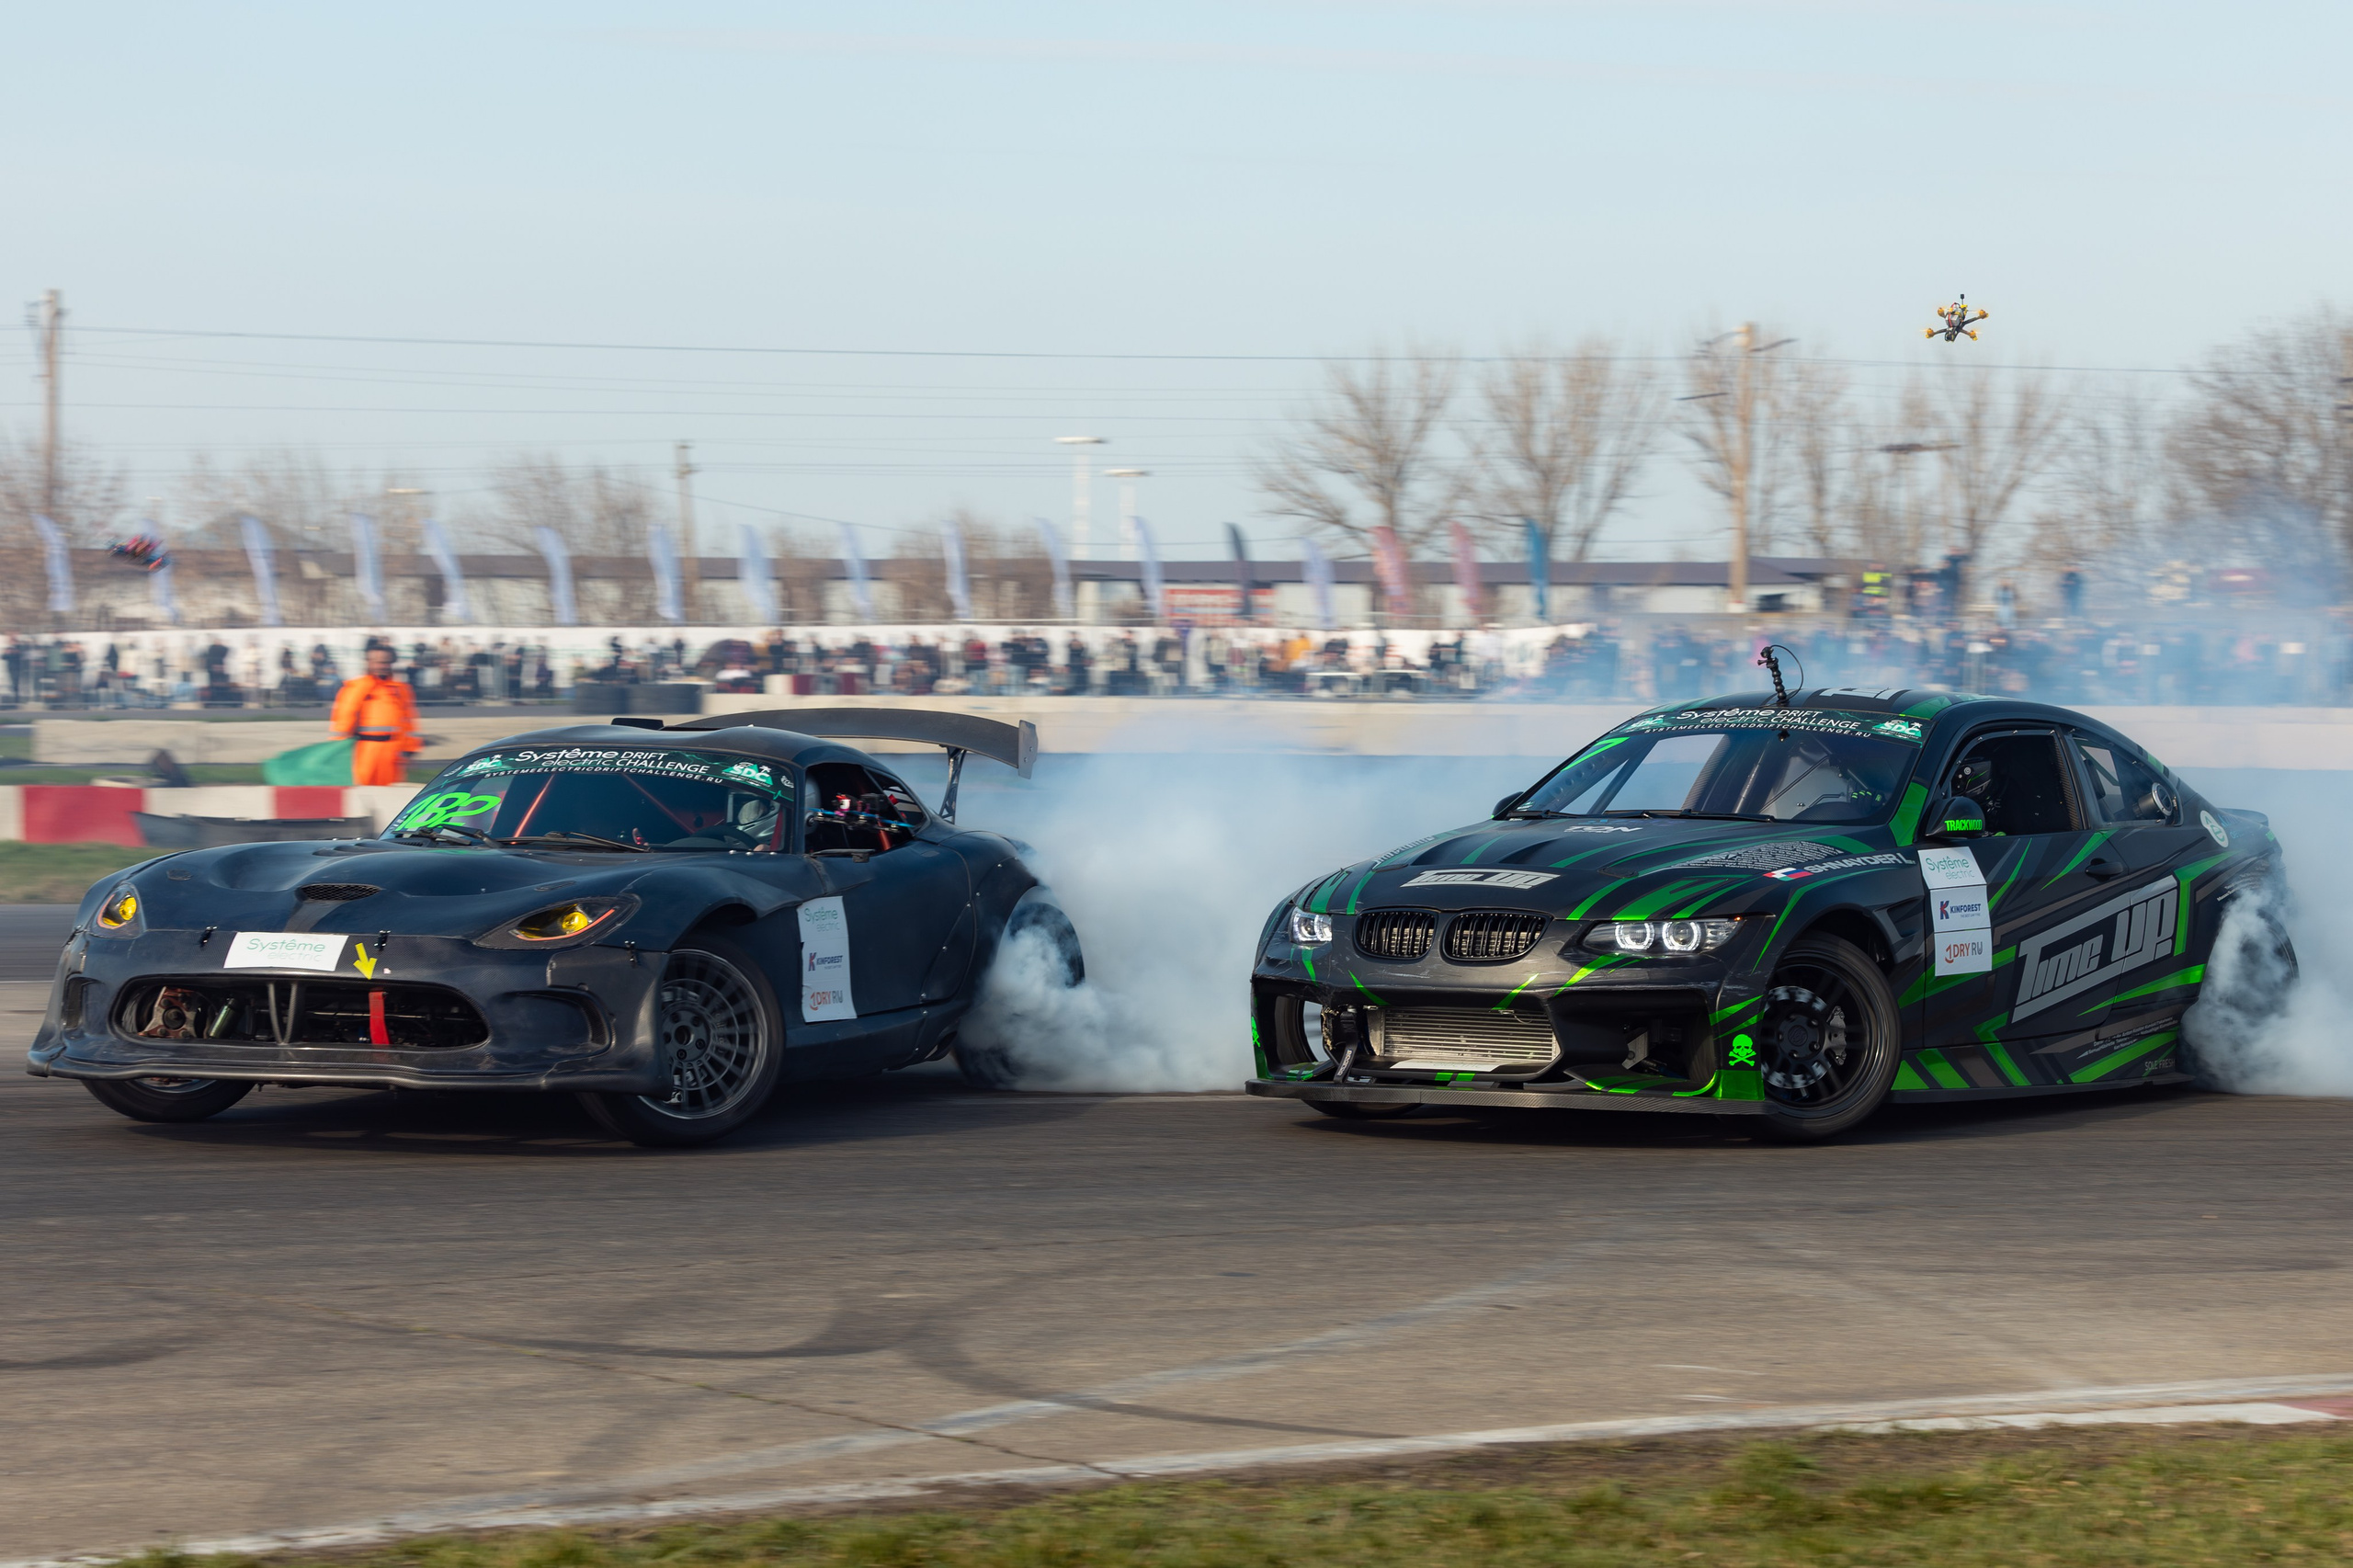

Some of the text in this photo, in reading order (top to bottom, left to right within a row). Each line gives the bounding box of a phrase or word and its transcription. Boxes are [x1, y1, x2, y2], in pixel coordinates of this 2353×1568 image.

[1677, 708, 1823, 720] Systême DRIFT
[1770, 716, 1861, 730] CHALLENGE
[1880, 722, 1920, 735] SDC
[515, 748, 668, 762] Systême DRIFT
[541, 757, 710, 774] electric CHALLENGE
[484, 767, 723, 784] SYSTEMEELECTRICDRIFTCHALLENGE.RU
[729, 765, 770, 782] SDC
[1945, 819, 1983, 832] TRACKWOOD
[1803, 853, 1899, 873] SHNAYDER
[1926, 856, 1970, 873] Systême
[1945, 869, 1975, 880] electric
[803, 906, 838, 925] Systême
[1949, 903, 1981, 914] KINFOREST
[246, 937, 326, 953] Systême
[267, 950, 322, 962] electric
